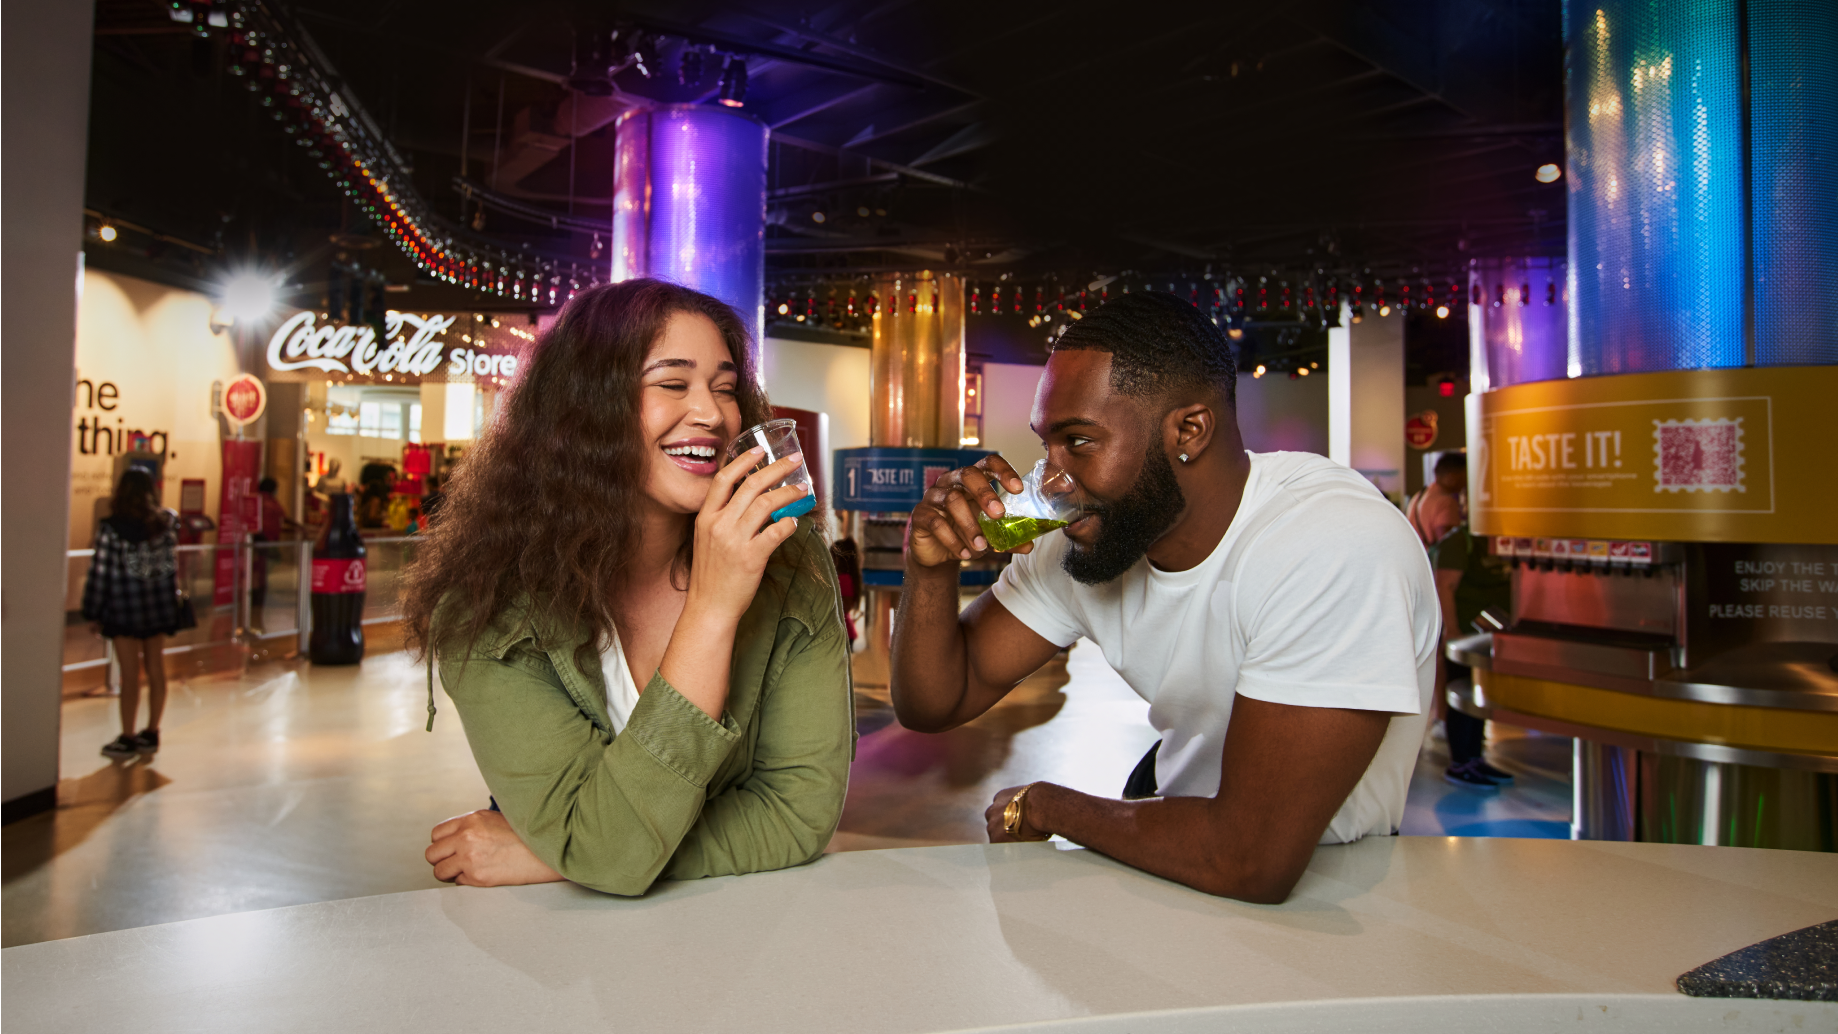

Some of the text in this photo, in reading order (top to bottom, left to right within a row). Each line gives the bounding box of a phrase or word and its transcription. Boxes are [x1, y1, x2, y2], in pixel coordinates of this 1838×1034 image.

[267, 310, 517, 376] Coca-Cola Store
[1507, 430, 1622, 471] TASTE IT!
[847, 467, 856, 497] 1
[1734, 560, 1786, 575] ENJOY
[1790, 561, 1825, 576] THE
[1740, 578, 1775, 592] SKIP
[1780, 579, 1813, 593] THE
[1709, 603, 1764, 618] PLEASE
[1769, 604, 1827, 619] REUSE
